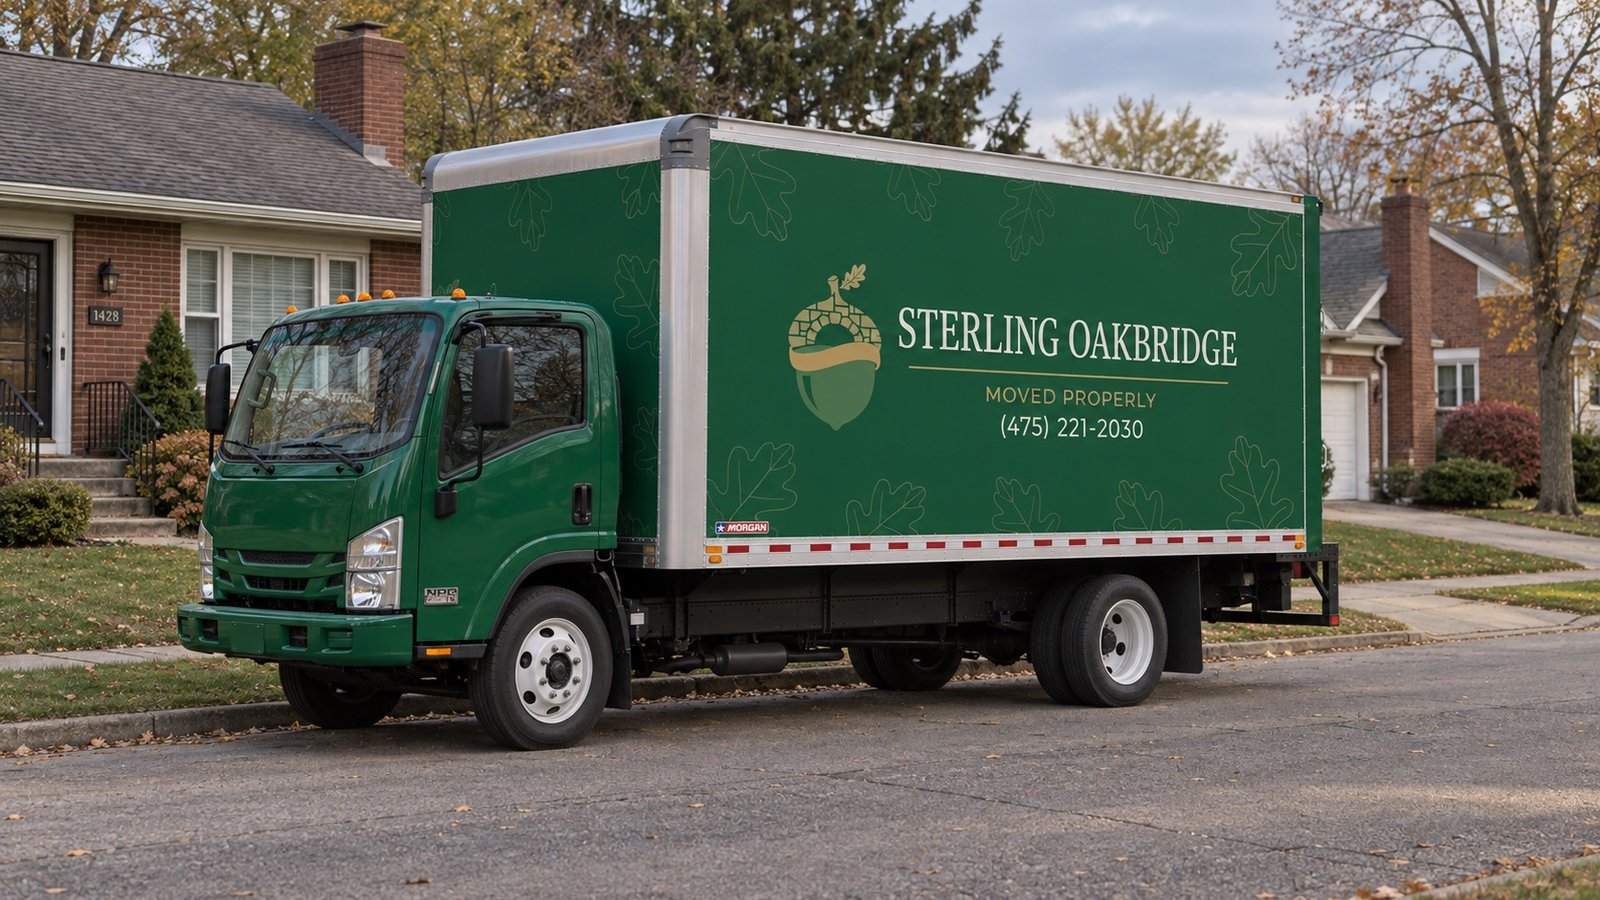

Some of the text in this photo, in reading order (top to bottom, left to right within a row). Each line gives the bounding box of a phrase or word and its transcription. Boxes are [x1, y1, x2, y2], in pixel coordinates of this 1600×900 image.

[94, 310, 119, 322] 1428
[898, 306, 1238, 366] STERLING OAKBRIDGE
[985, 386, 1157, 408] MOVED PROPERLY
[1000, 414, 1144, 439] (475) 221-2030
[727, 523, 767, 532] MORGAN
